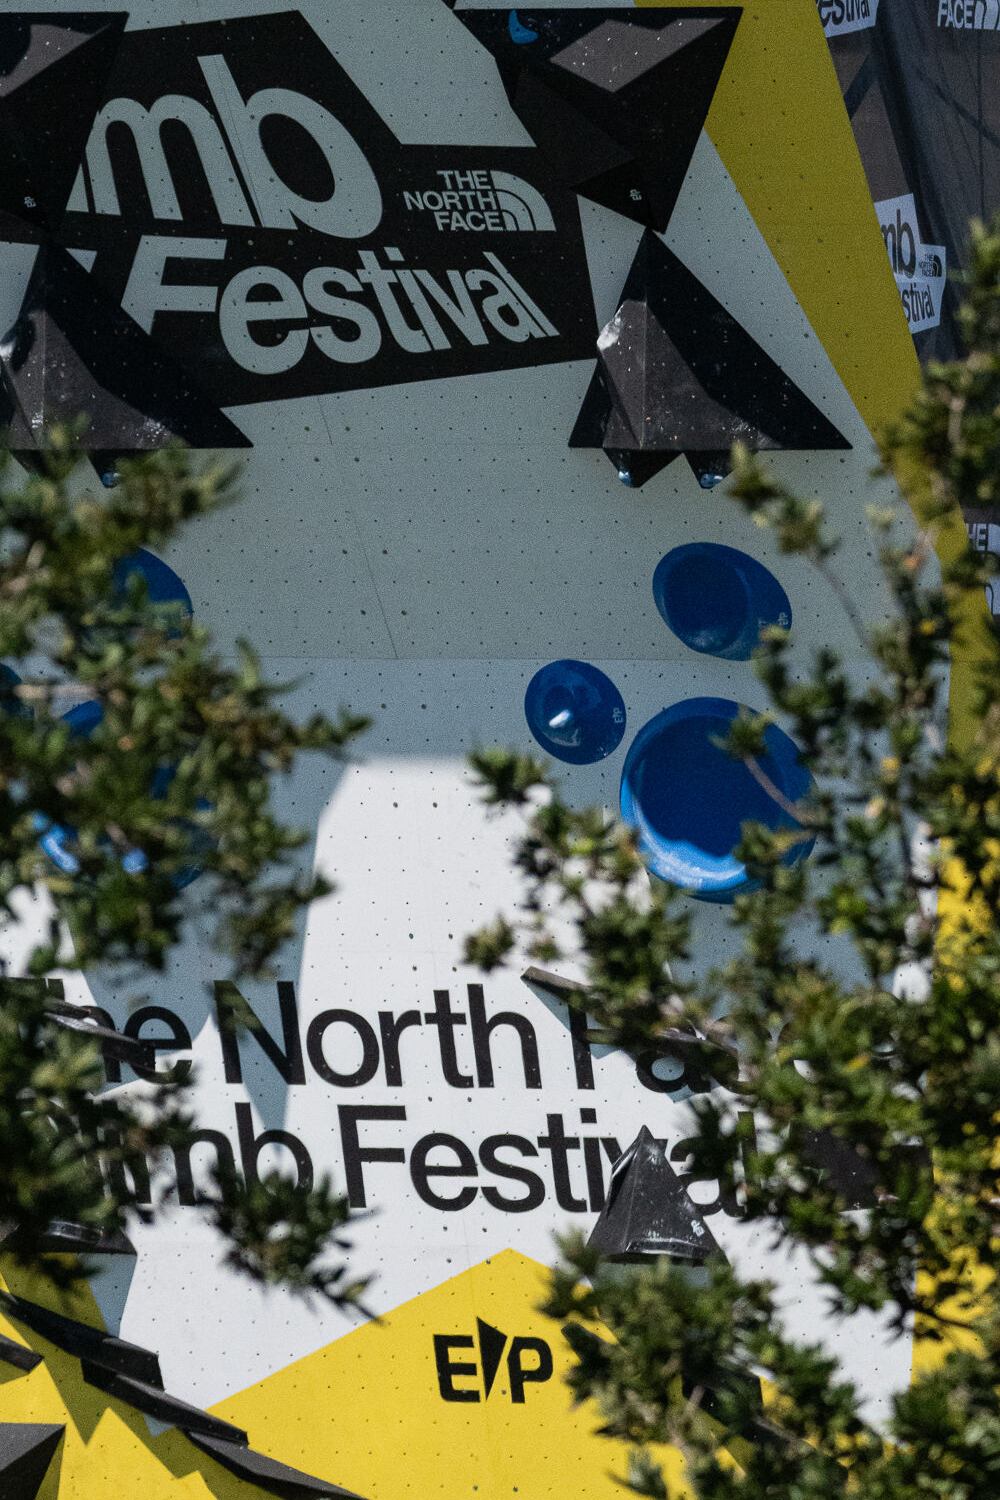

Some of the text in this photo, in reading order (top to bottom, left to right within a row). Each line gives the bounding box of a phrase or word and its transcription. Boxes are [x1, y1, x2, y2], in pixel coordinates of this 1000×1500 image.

[436, 170, 491, 190] THE
[403, 191, 498, 211] NORTH
[434, 211, 503, 232] FACE
[120, 235, 560, 375] Festival
[902, 282, 935, 323] stival
[213, 980, 543, 1090] North
